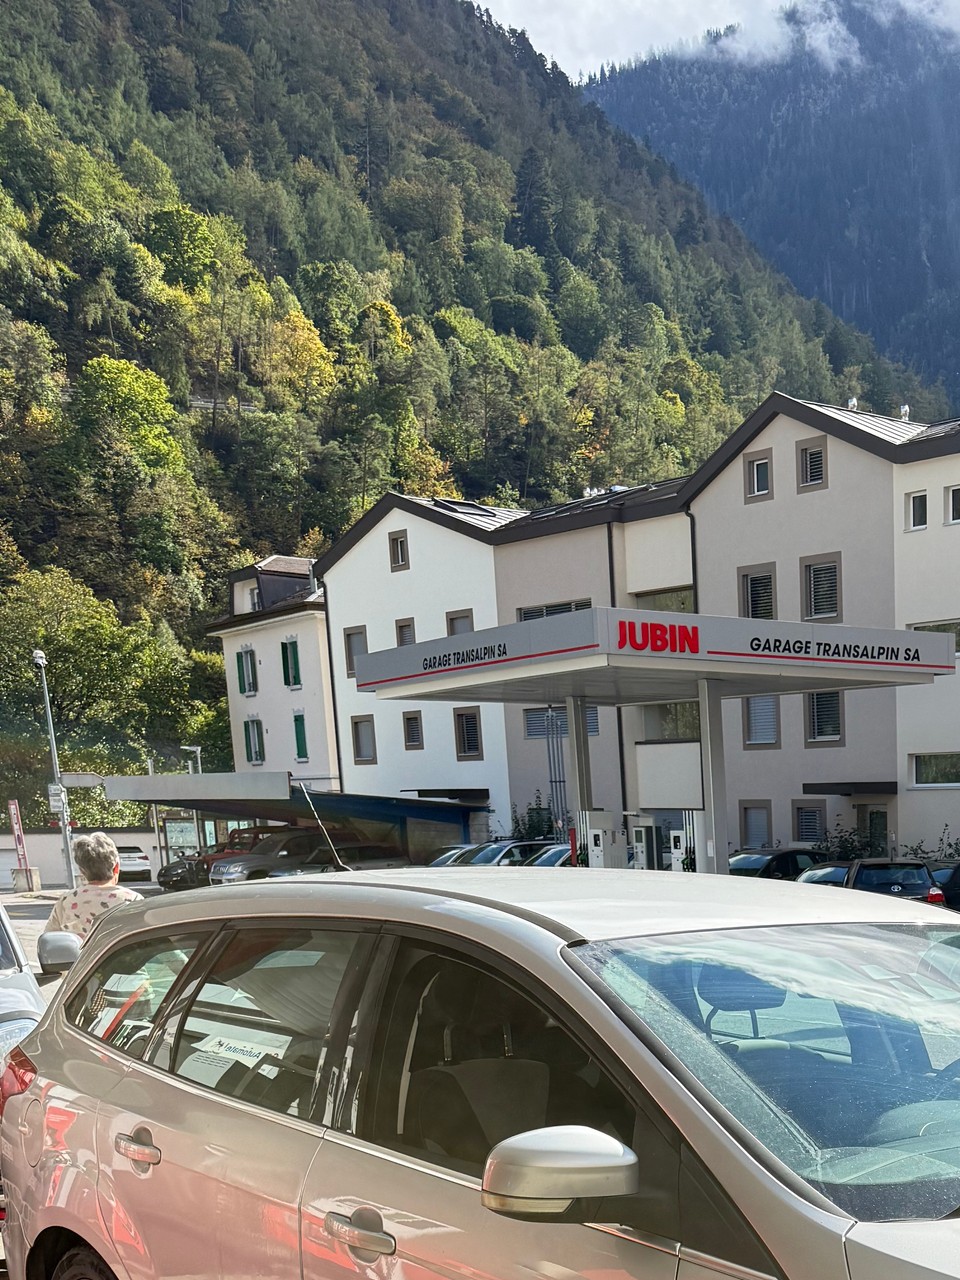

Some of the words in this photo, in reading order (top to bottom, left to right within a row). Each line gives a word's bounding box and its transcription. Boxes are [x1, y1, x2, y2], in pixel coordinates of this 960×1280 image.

[618, 620, 700, 654] JUBIN
[750, 637, 812, 655] GARAGE
[816, 642, 900, 661] TRANSALPIN
[903, 647, 921, 662] SA
[422, 652, 452, 671] GARAGE
[452, 644, 496, 666] TRANSALPIN
[497, 642, 508, 658] SA
